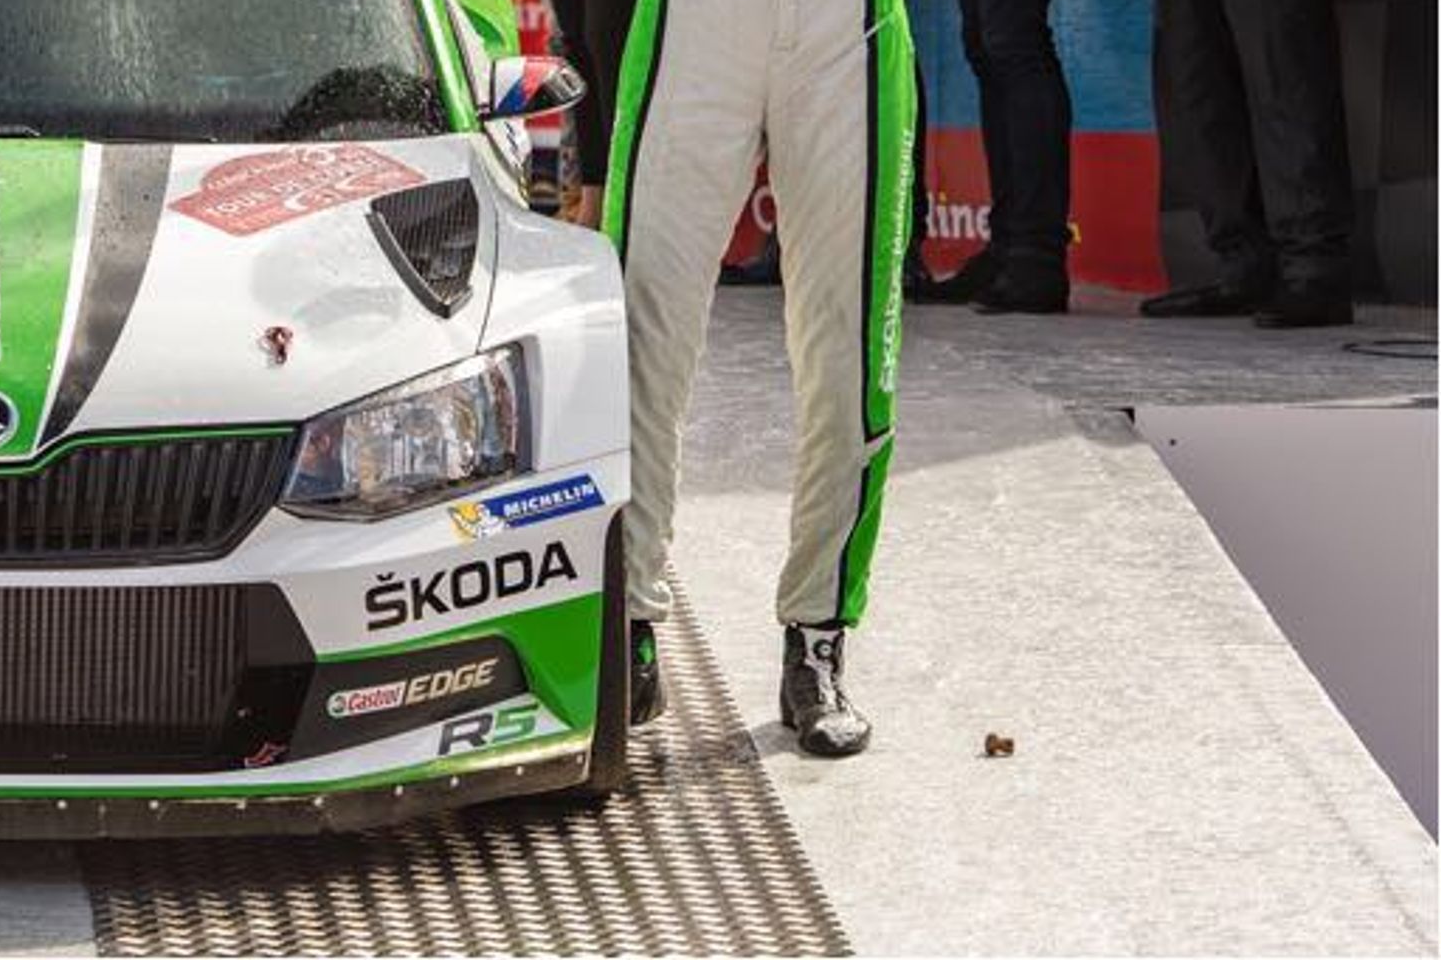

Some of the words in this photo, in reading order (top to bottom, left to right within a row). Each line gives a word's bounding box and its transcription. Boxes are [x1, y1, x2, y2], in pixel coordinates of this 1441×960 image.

[503, 486, 595, 516] MICHELIN
[365, 541, 577, 631] ŠKODA
[346, 685, 401, 712] Castrol
[405, 658, 499, 705] EDGE
[437, 703, 540, 756] R5
